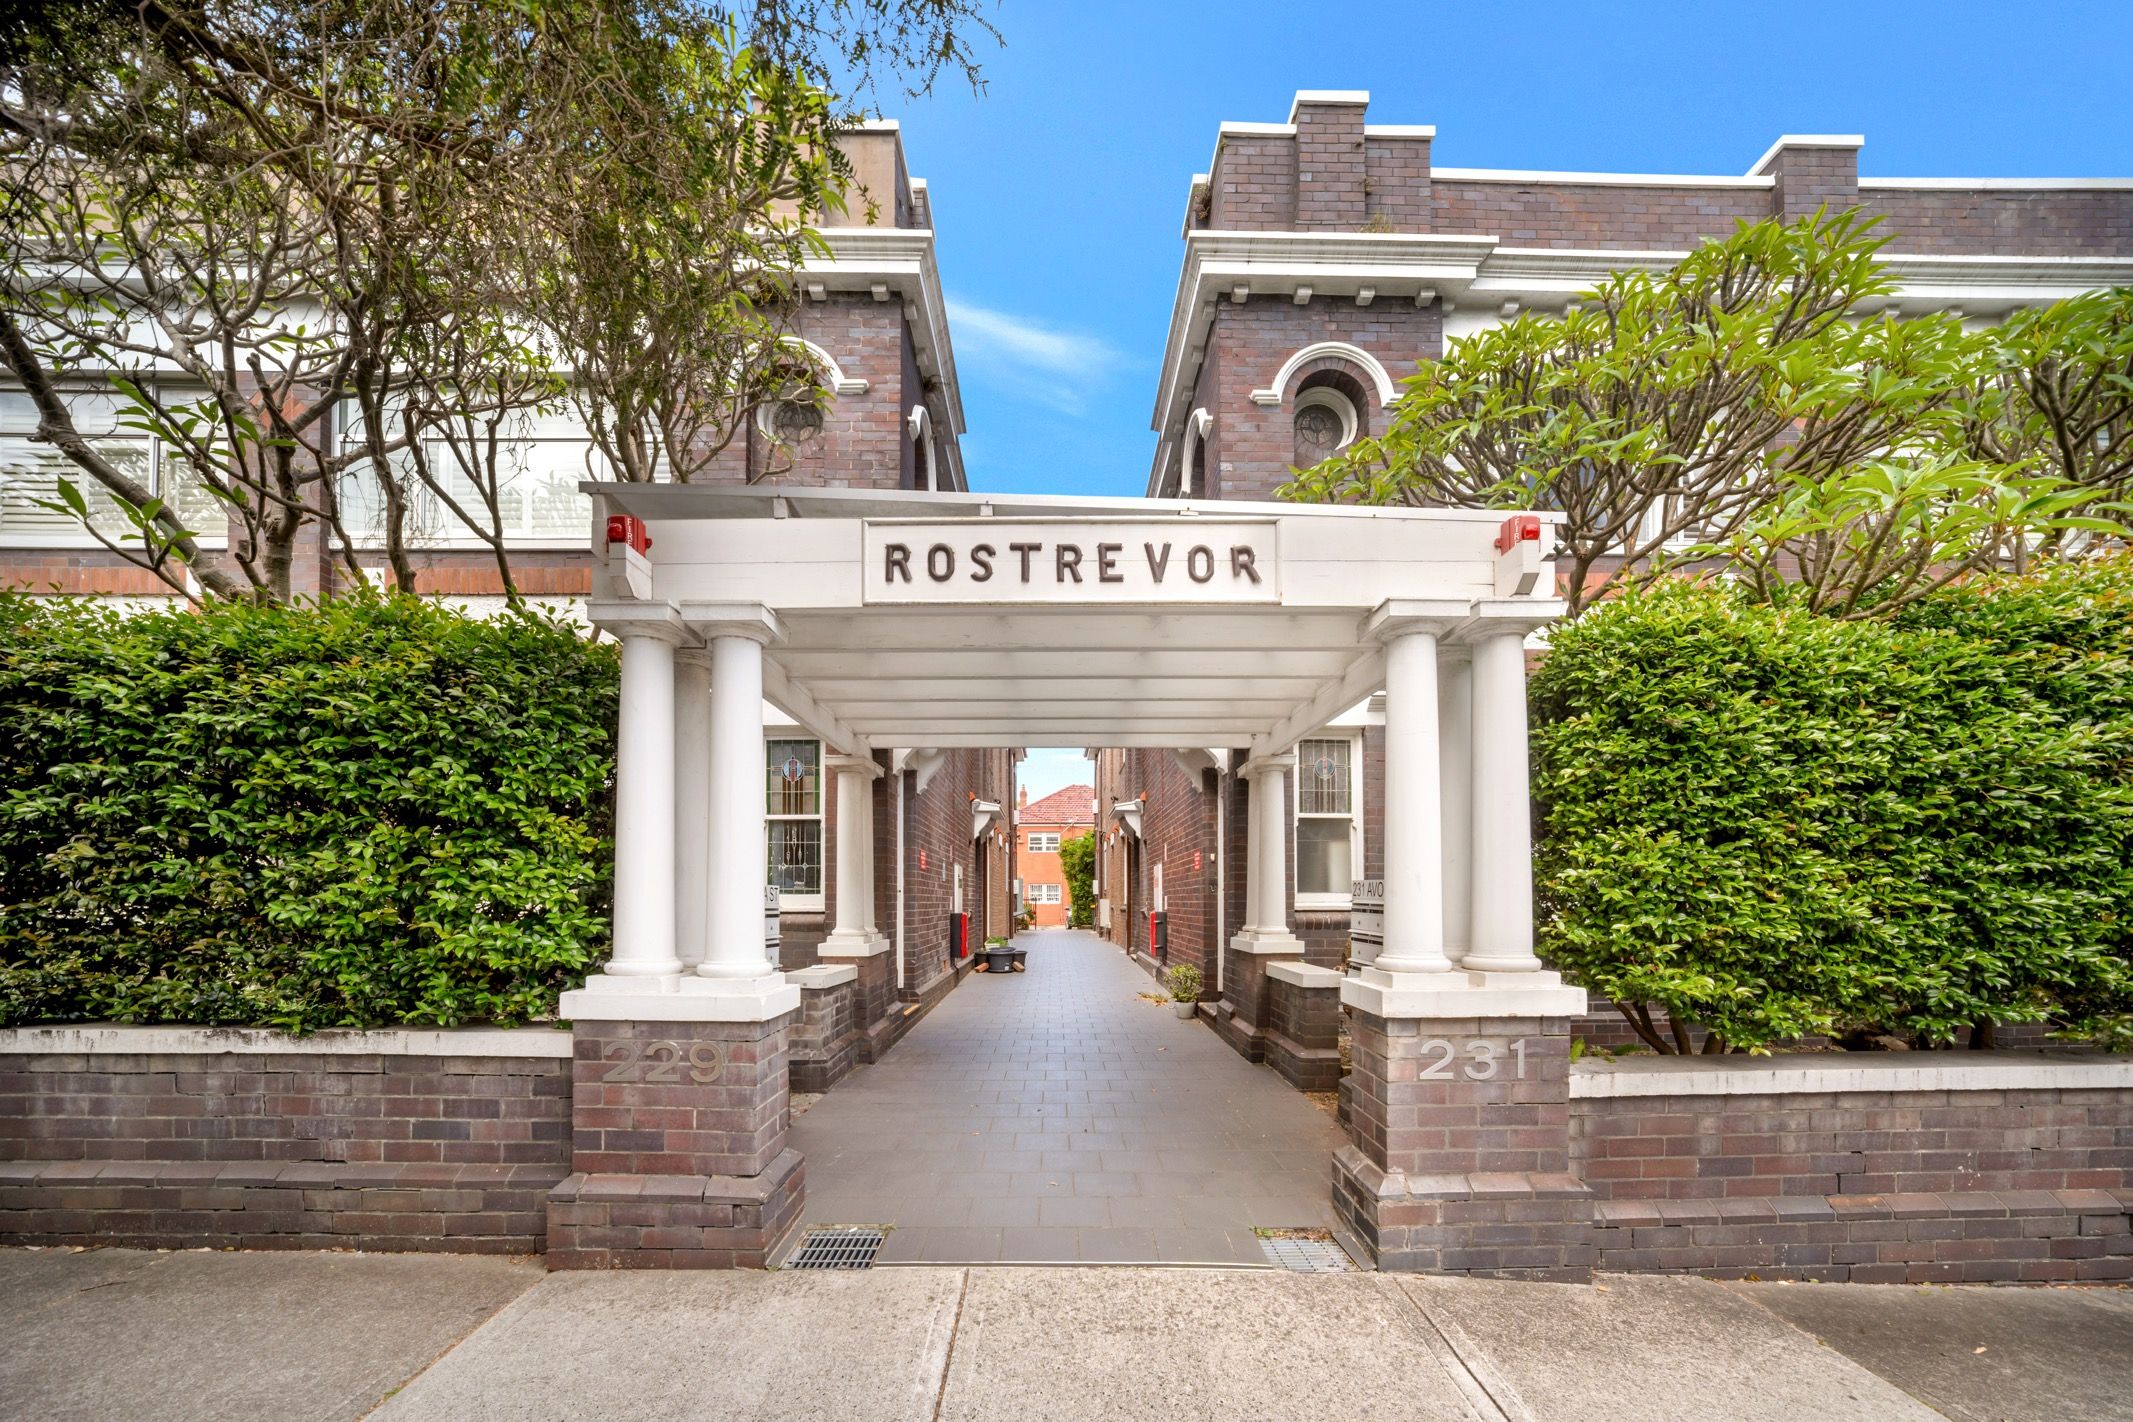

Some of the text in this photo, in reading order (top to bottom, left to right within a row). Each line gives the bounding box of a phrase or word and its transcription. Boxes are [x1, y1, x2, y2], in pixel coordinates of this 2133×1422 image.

[884, 541, 1263, 584] ROSTREVOR
[1352, 882, 1365, 897] 231
[602, 1040, 724, 1083] 229
[1419, 1038, 1526, 1081] 231
